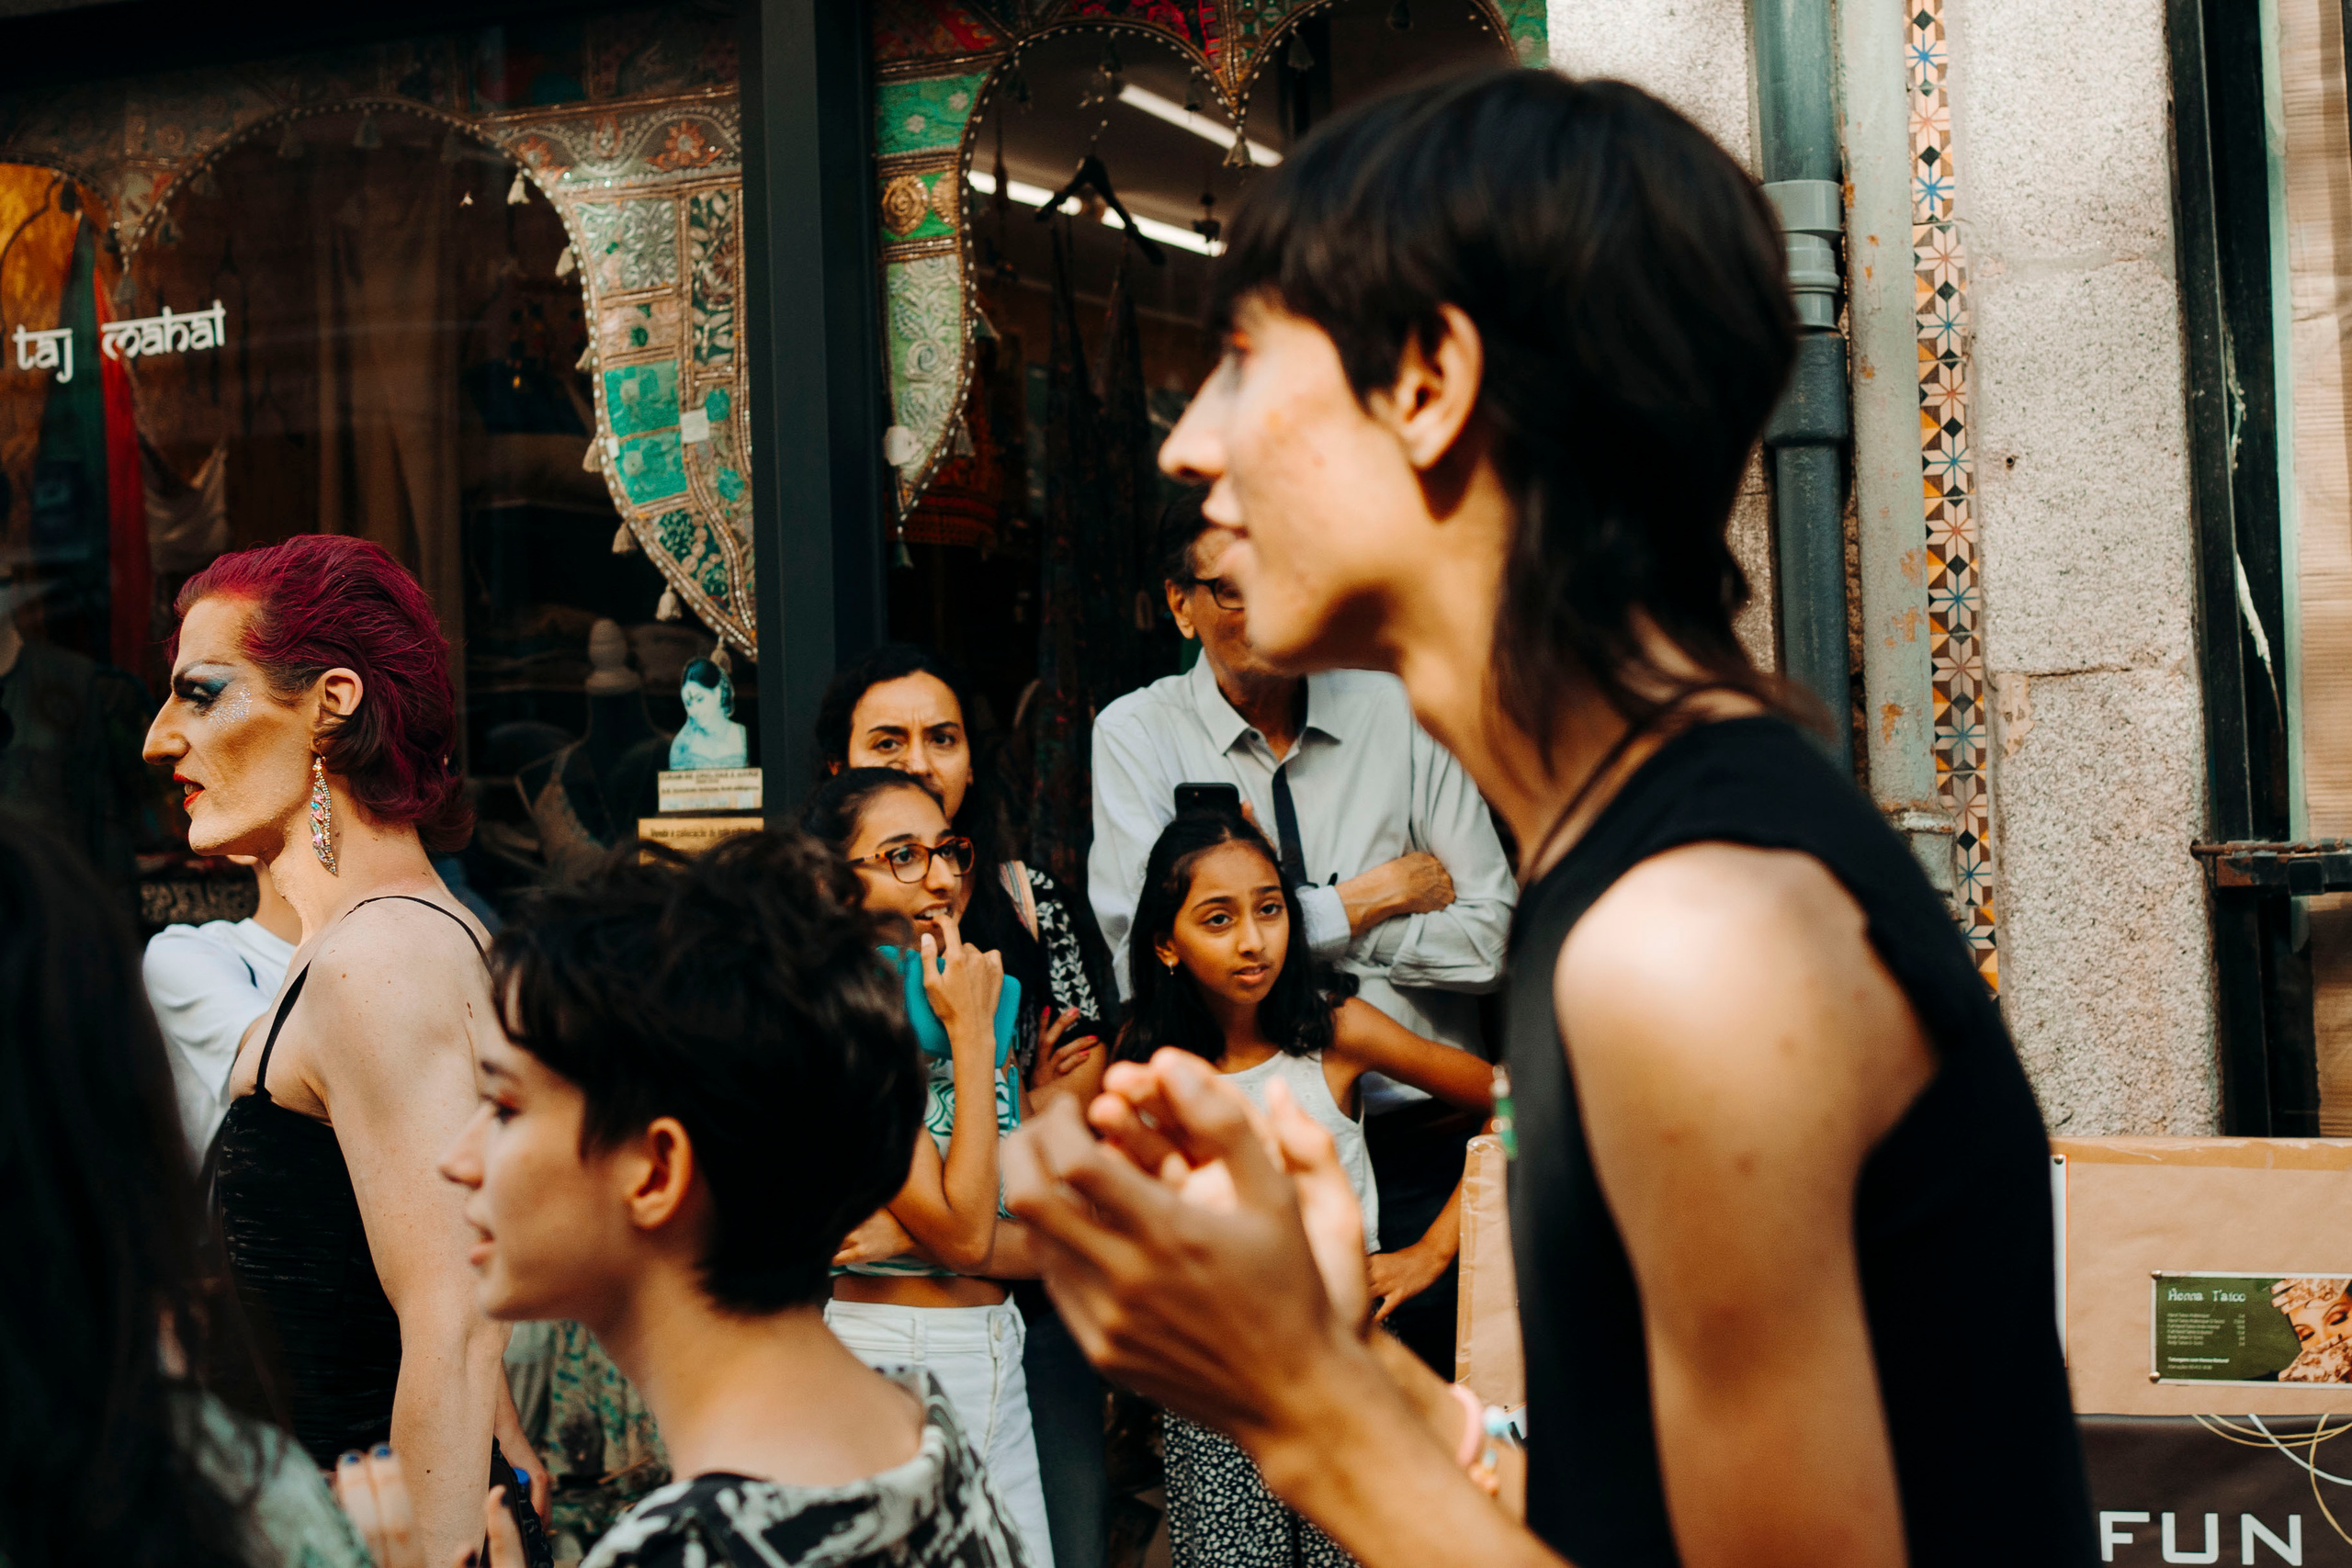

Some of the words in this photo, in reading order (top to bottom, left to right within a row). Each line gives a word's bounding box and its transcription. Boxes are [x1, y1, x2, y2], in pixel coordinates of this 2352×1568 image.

[12, 323, 74, 384] taj
[101, 299, 226, 361] mahal
[2168, 1288, 2204, 1302] Henna
[2099, 1510, 2302, 1566] FUN
